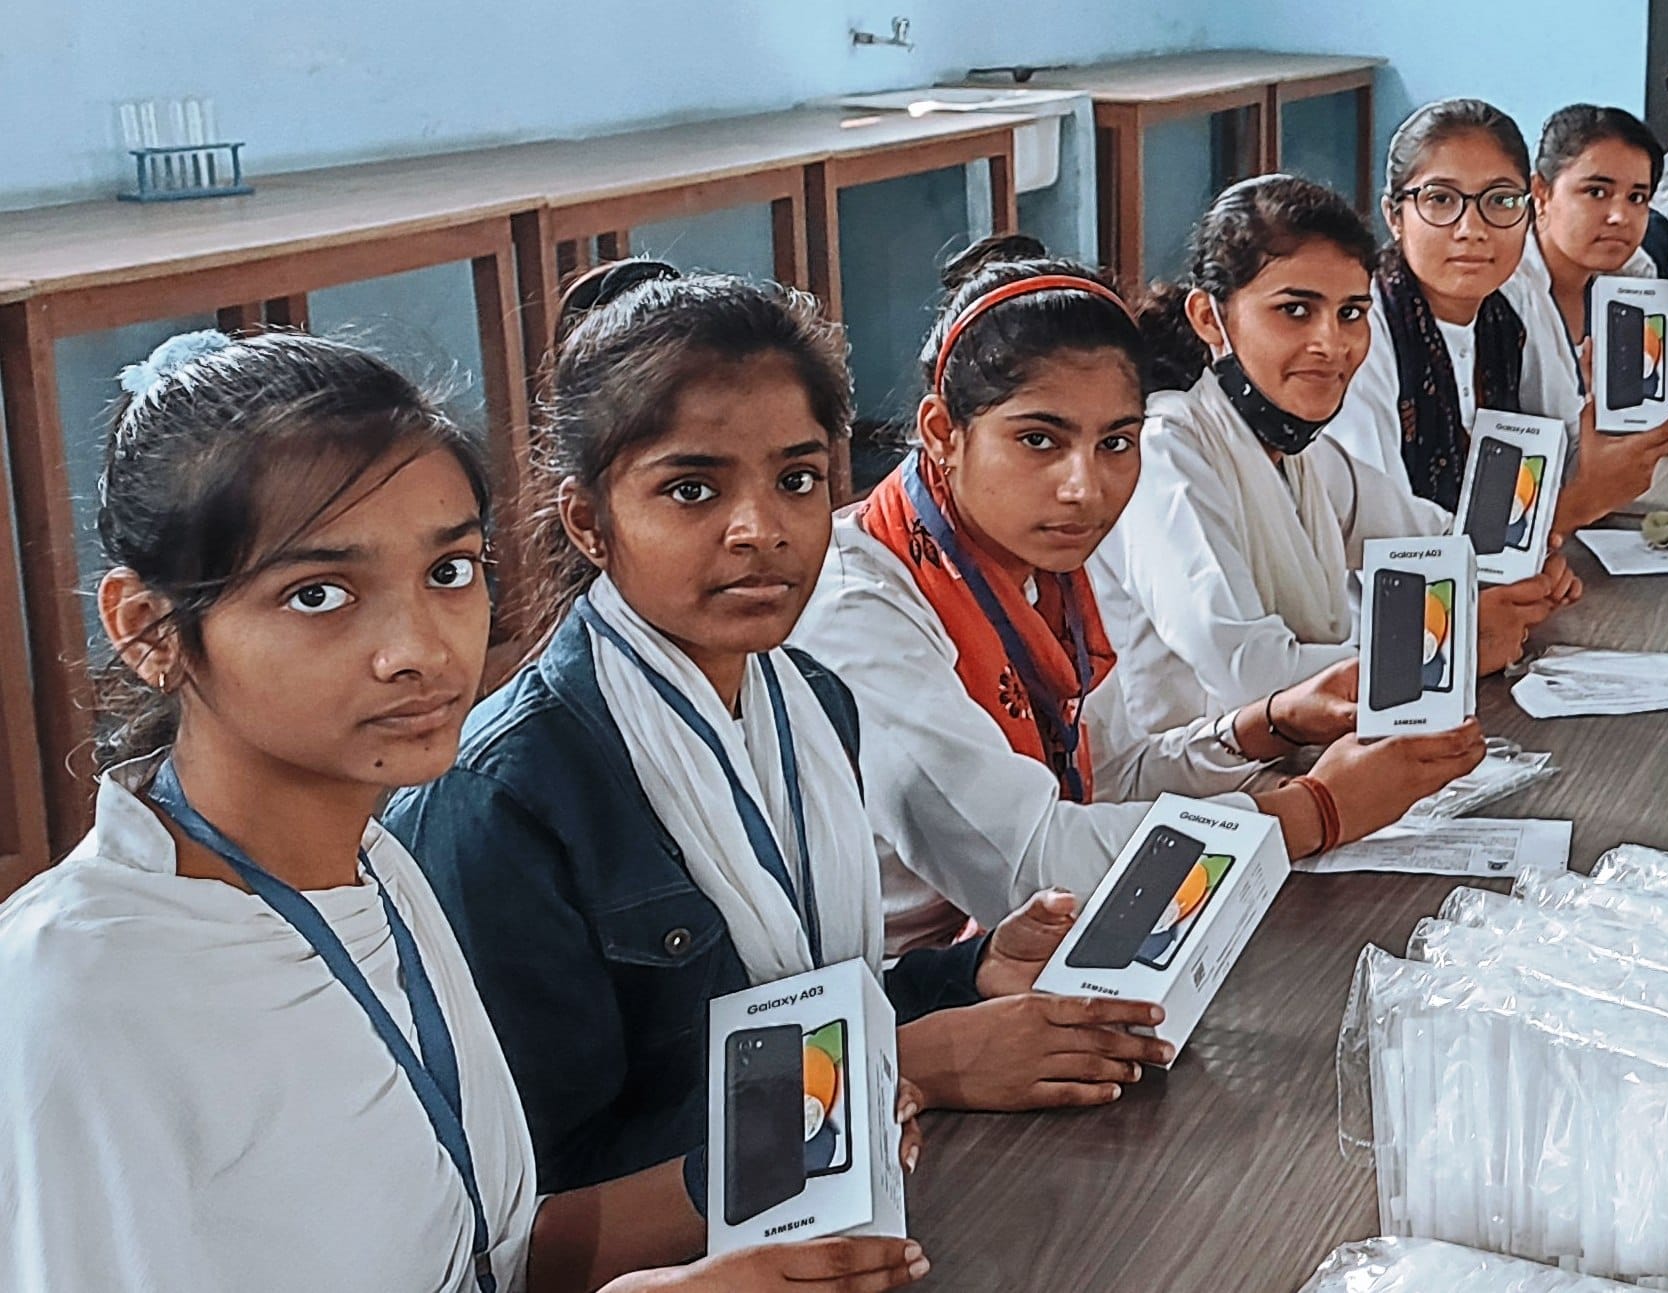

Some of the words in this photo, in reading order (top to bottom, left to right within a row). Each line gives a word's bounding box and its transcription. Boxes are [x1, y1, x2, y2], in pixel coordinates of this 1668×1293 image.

[1389, 550, 1424, 560] Galaxy
[1425, 549, 1442, 558] A03
[1179, 811, 1219, 828] Galaxy
[1219, 820, 1239, 831] A03
[747, 993, 798, 1015] Galaxy
[800, 985, 824, 1001] A03
[764, 1216, 815, 1238] SAMSUNG
